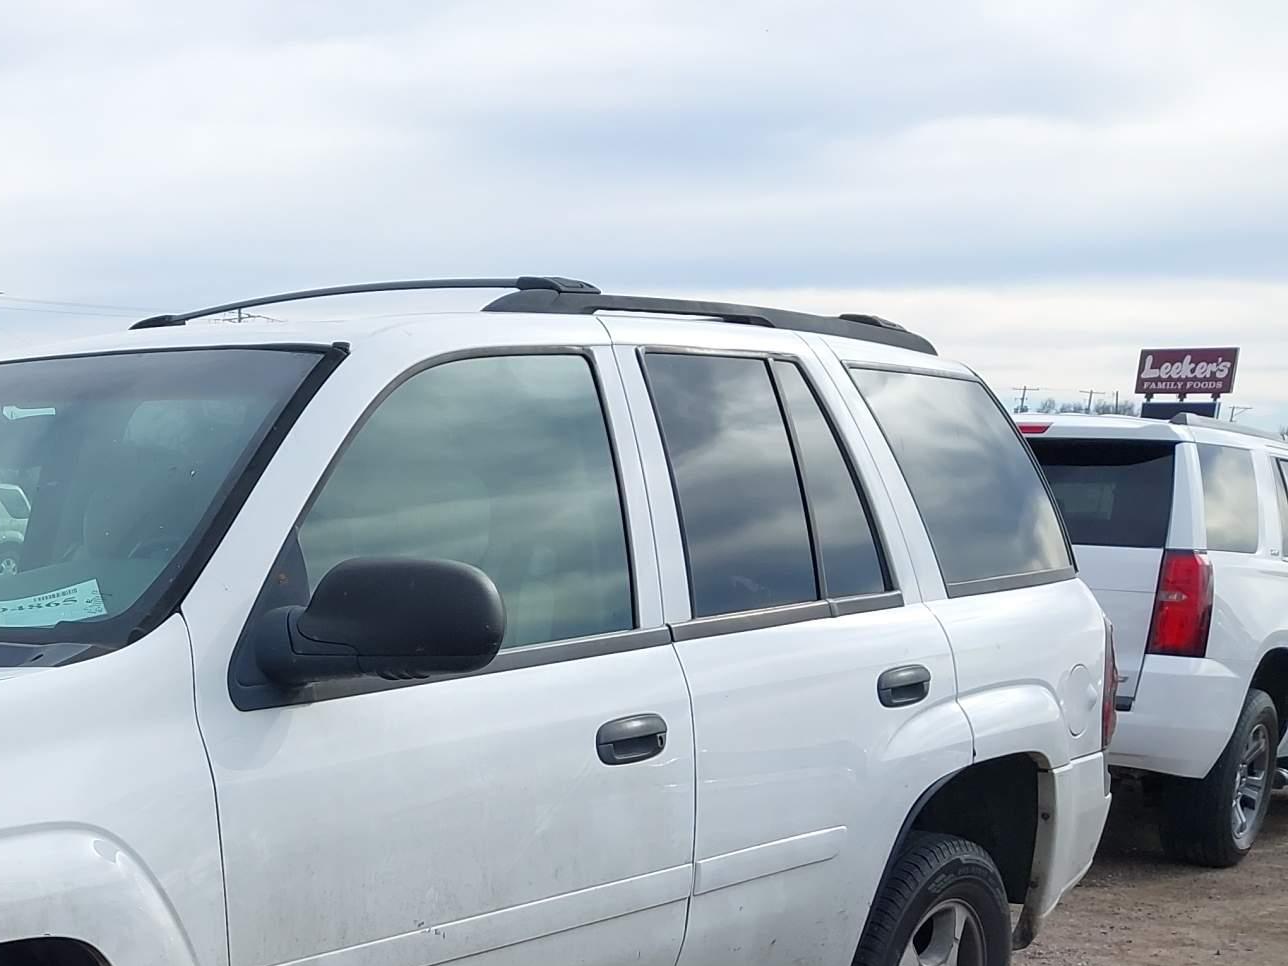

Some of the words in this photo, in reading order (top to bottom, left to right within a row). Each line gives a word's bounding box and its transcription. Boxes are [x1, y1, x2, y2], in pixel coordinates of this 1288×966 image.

[1141, 354, 1231, 379] Leeker's
[1143, 381, 1183, 389] FAMILY
[1187, 380, 1223, 389] FOODS
